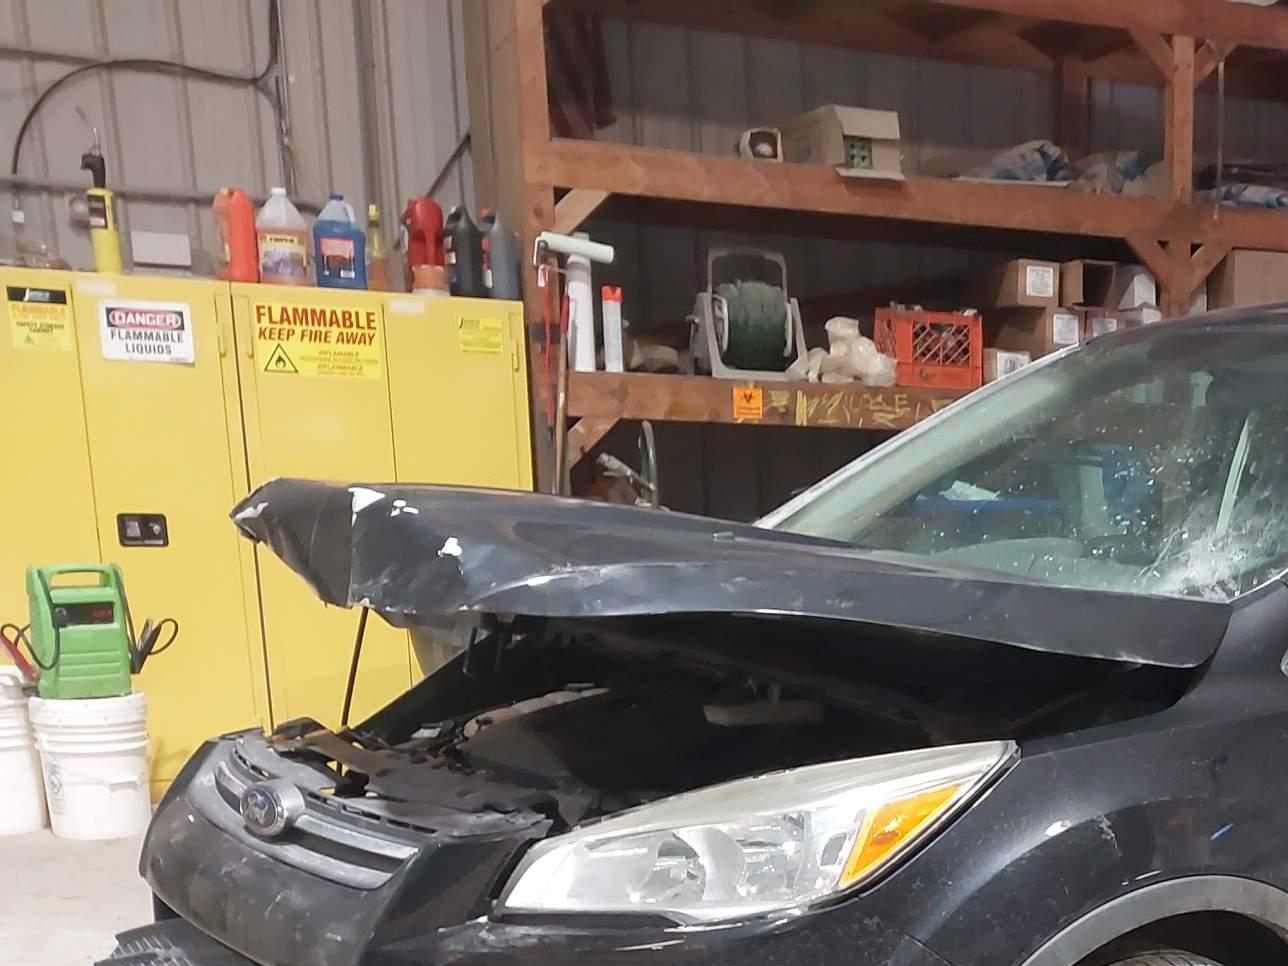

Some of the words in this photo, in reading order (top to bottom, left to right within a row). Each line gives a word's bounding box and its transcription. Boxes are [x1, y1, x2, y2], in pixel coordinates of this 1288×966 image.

[114, 311, 177, 328] DANGER
[256, 305, 377, 330] FLAMMABLE
[110, 330, 184, 344] FLAMMABLE
[257, 325, 296, 341] KEEP
[300, 328, 332, 344] FIRE
[335, 330, 377, 346] AWAY
[125, 343, 173, 356] LIQUIDS
